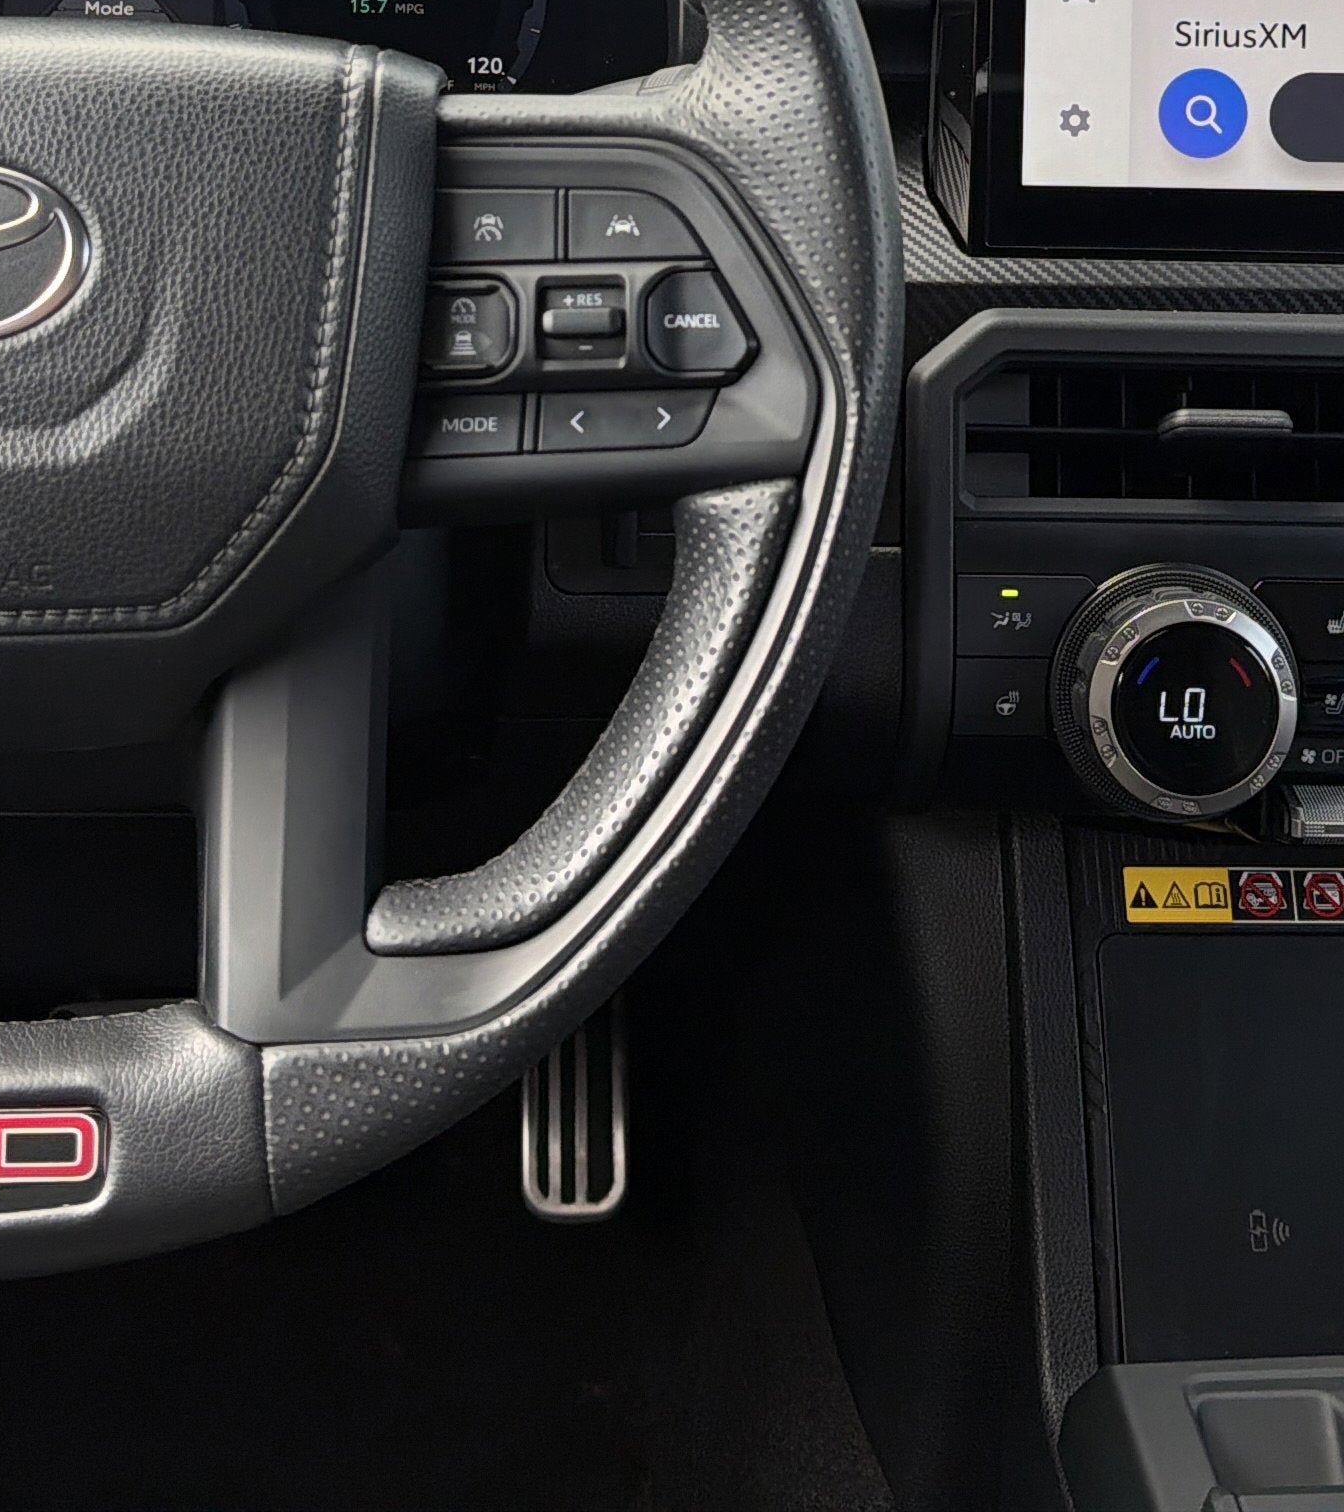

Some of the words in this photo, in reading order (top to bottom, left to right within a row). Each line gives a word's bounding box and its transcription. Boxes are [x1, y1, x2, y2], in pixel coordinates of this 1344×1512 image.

[85, 0, 134, 16] Mode
[395, 3, 425, 15] MPG
[1174, 20, 1308, 50] SiriusXM
[467, 56, 503, 75] 120
[473, 82, 496, 92] MPH
[664, 313, 720, 329] CANCEL
[442, 416, 498, 434] MODE
[1159, 688, 1206, 722] LO
[1170, 725, 1216, 740] AUTO
